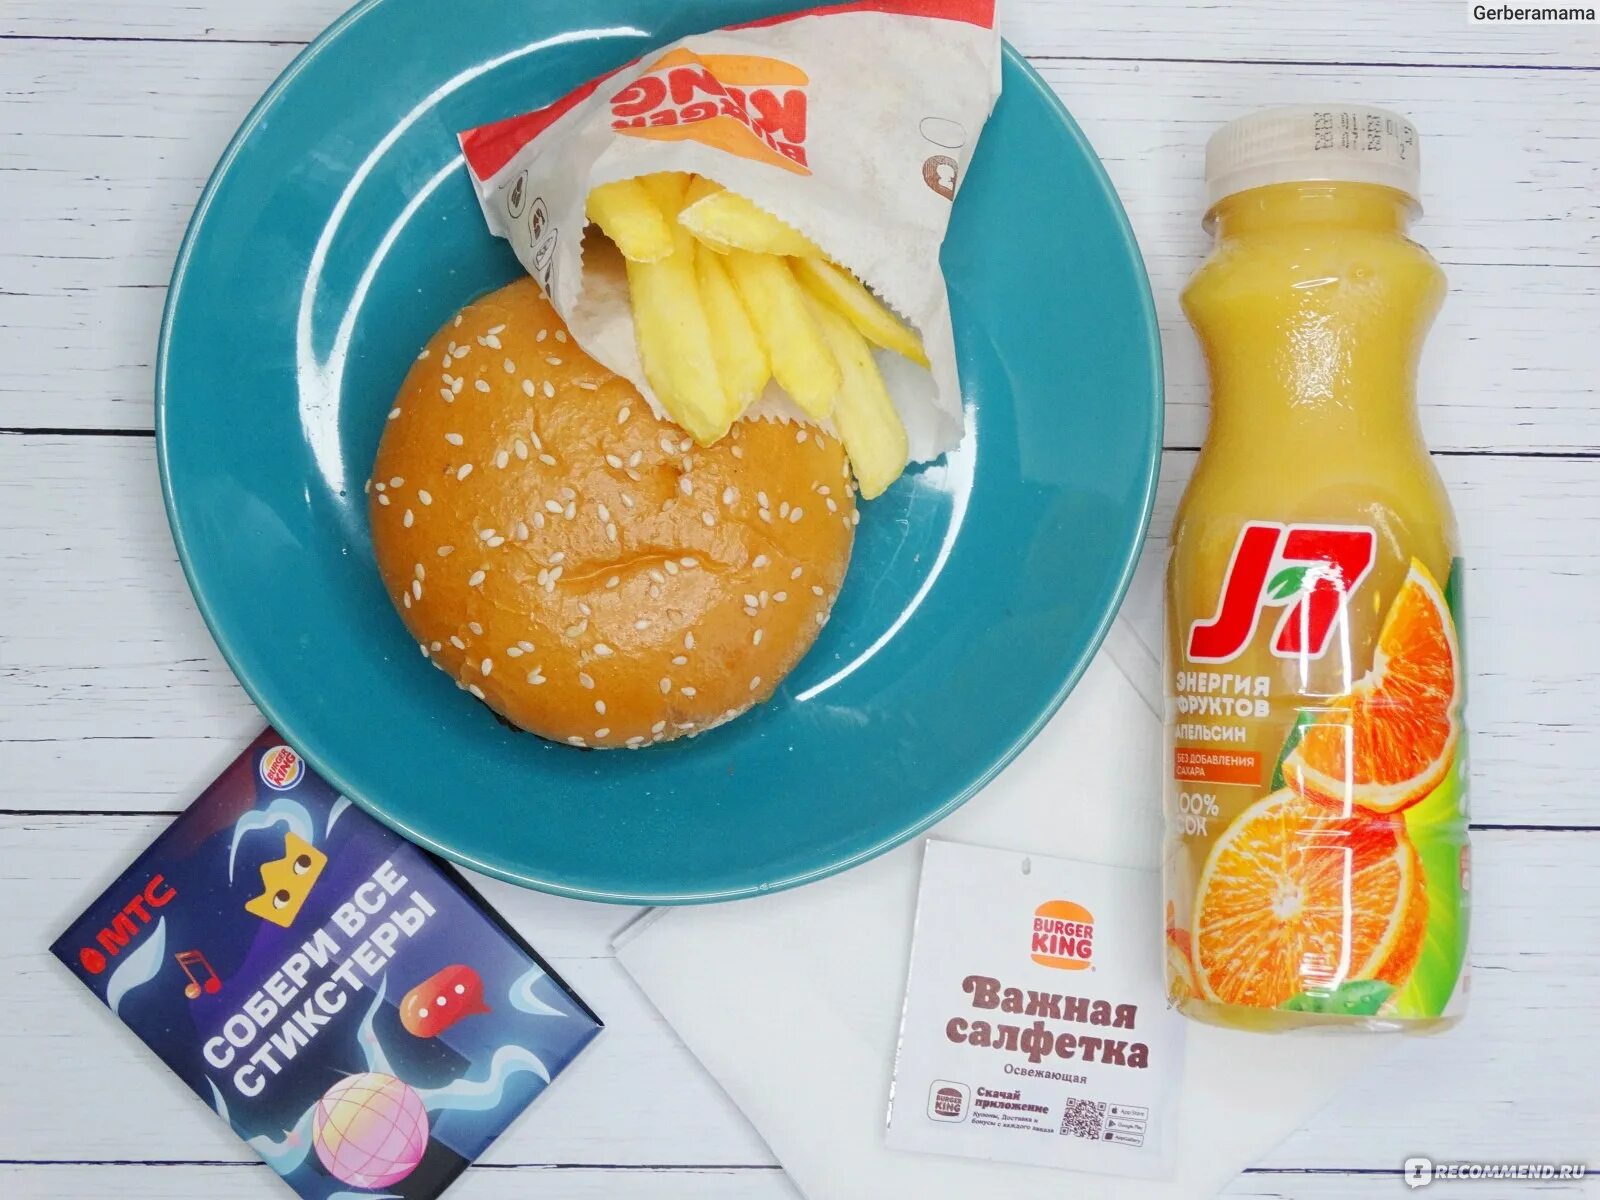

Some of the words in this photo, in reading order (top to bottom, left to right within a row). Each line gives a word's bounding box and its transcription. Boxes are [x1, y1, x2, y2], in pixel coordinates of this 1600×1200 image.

[1187, 520, 1376, 664] J7
[1176, 671, 1271, 697] ЭНЕРГИЯ
[1176, 695, 1270, 718] ФРУКТОВ
[267, 748, 287, 780] BURGER
[273, 752, 296, 786] KING
[1176, 766, 1206, 777] САХАРА
[1177, 752, 1190, 764] БЕЗ
[1190, 753, 1255, 767] ДОБАВЛЕНИЯ
[1175, 792, 1220, 817] 00%
[95, 873, 177, 956] МТС
[1033, 917, 1093, 939] BURGER
[1031, 932, 1093, 959] KING
[202, 928, 341, 1069] СОБЕРИ
[330, 860, 409, 938] ВСЕ
[233, 890, 437, 1097] СТИКСТЕРЫ
[961, 974, 1138, 1030] Важная
[945, 1016, 1150, 1069] салфетка
[1003, 1063, 1087, 1085] Освежающая
[974, 1098, 1050, 1115] приложение
[976, 1086, 1021, 1101] Скачай
[934, 1101, 961, 1113] KING
